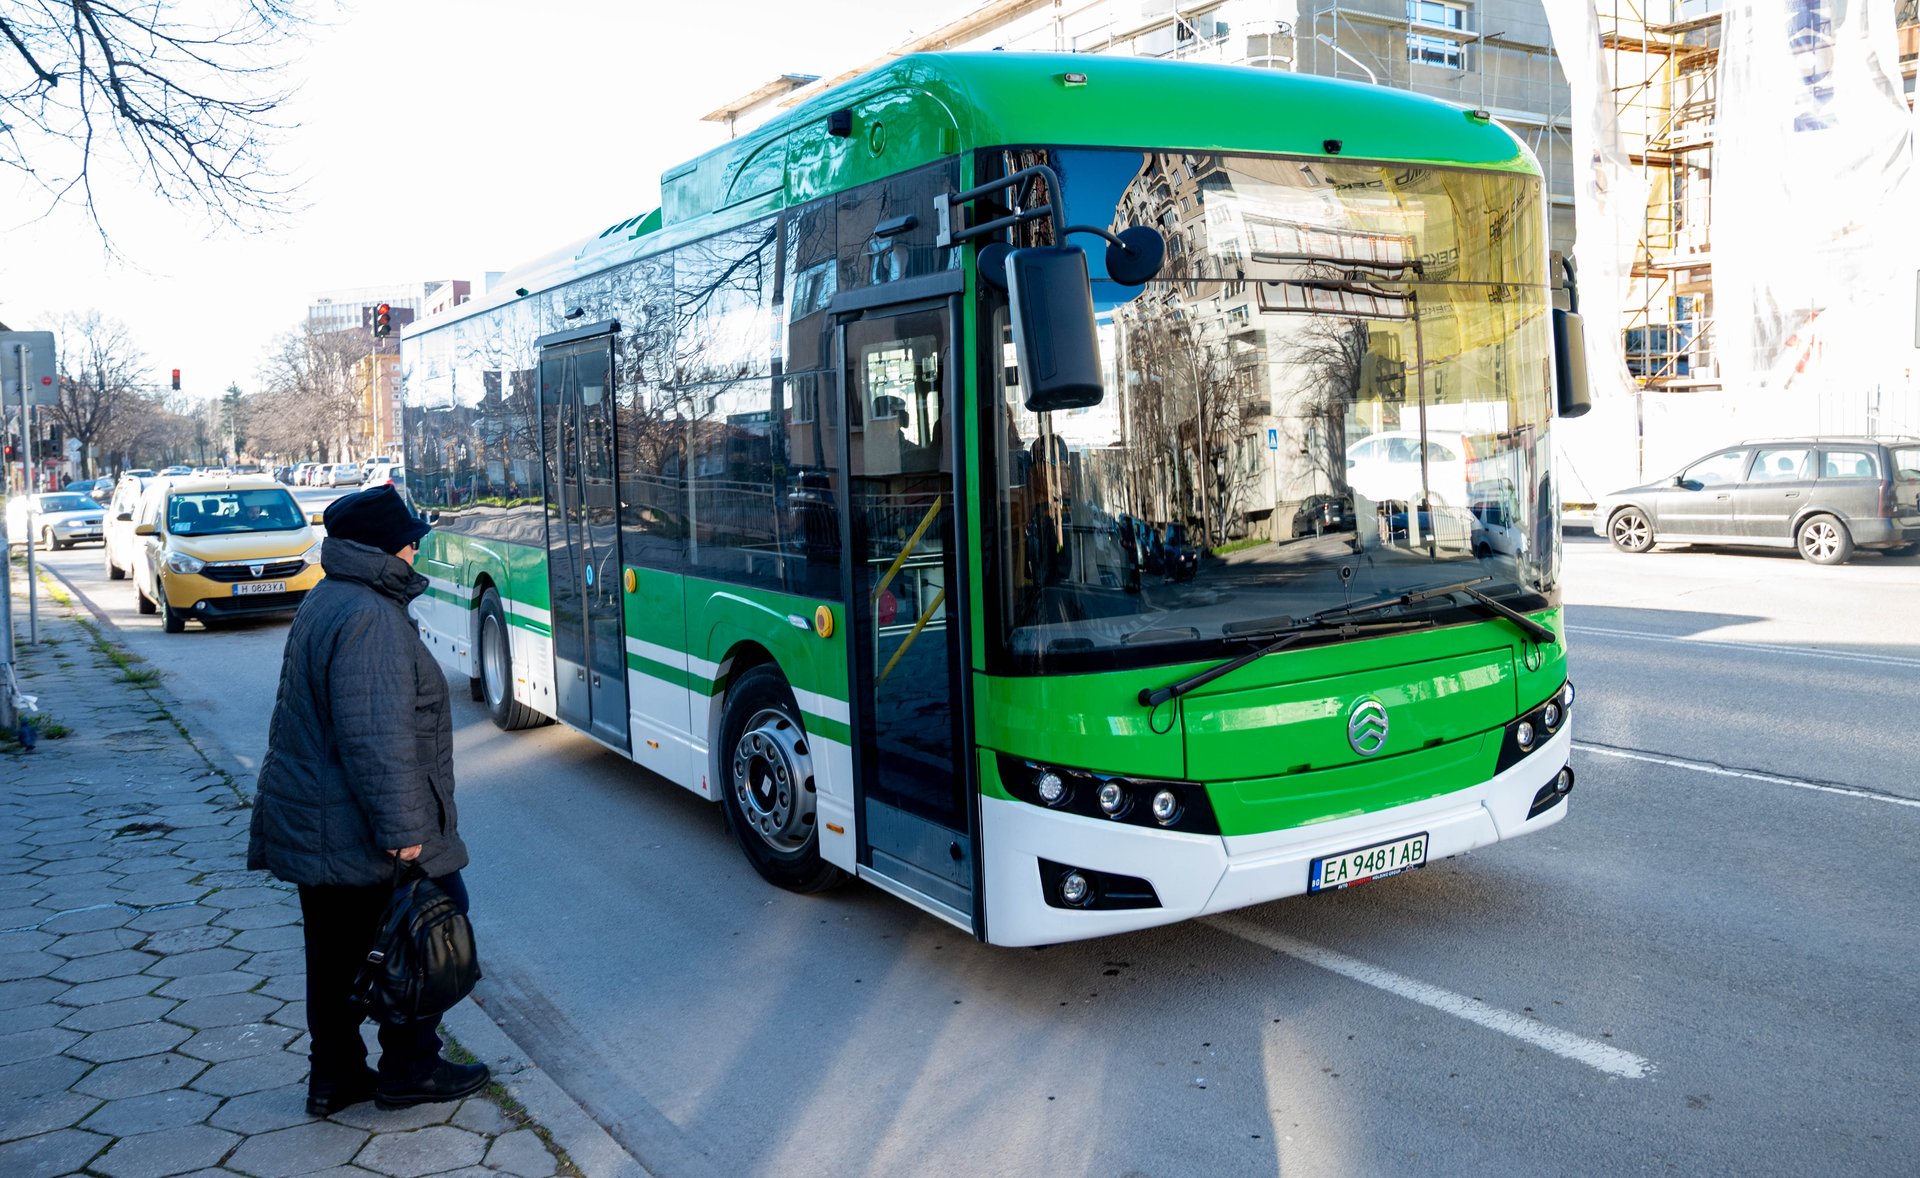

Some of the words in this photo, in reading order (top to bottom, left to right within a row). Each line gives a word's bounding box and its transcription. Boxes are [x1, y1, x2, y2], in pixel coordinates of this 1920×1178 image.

[241, 585, 248, 593] H
[1324, 858, 1348, 884] EA
[1353, 846, 1396, 876] 9481
[1400, 840, 1423, 865] AB
[1312, 879, 1320, 888] BG
